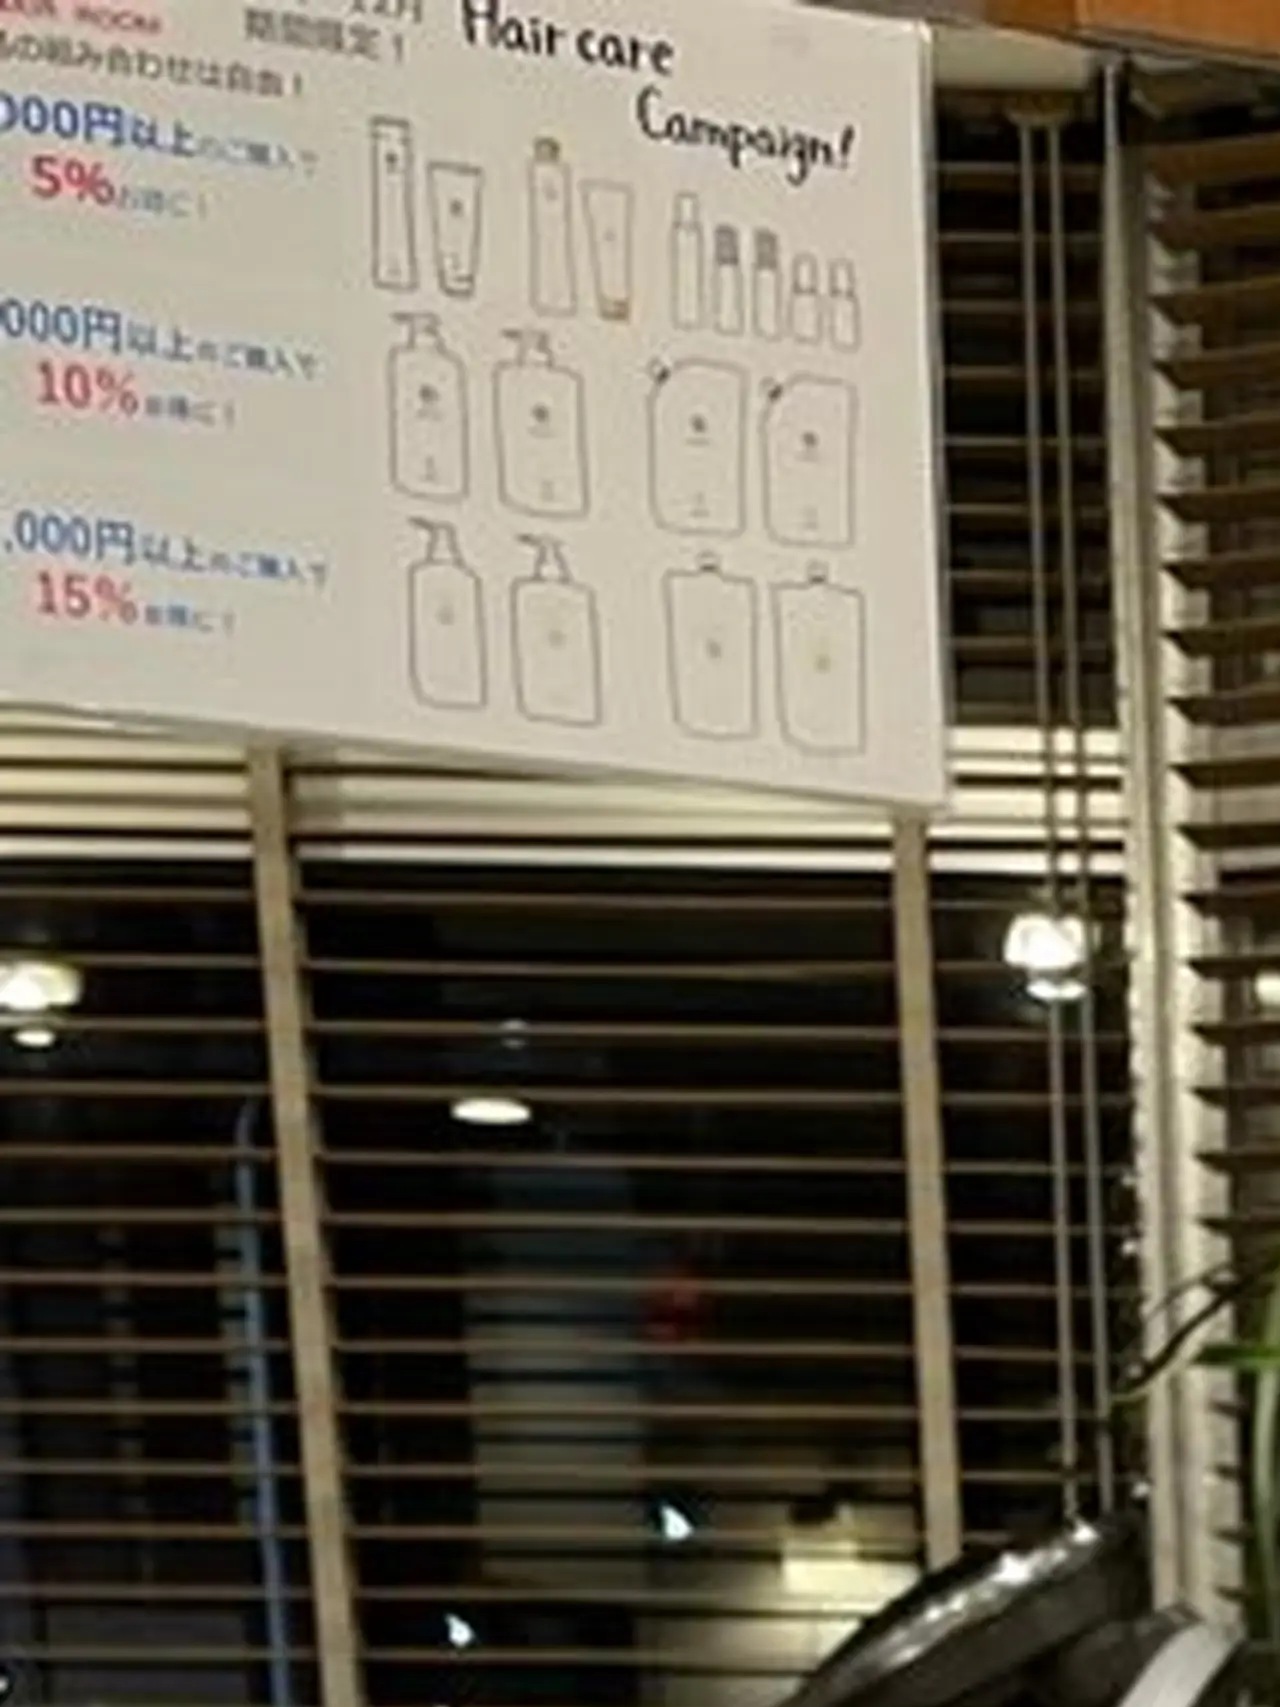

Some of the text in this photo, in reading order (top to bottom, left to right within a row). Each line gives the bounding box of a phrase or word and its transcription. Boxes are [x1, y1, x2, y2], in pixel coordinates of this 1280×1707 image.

[462, 0, 676, 77] Hair care
[635, 85, 855, 187] Campaign!
